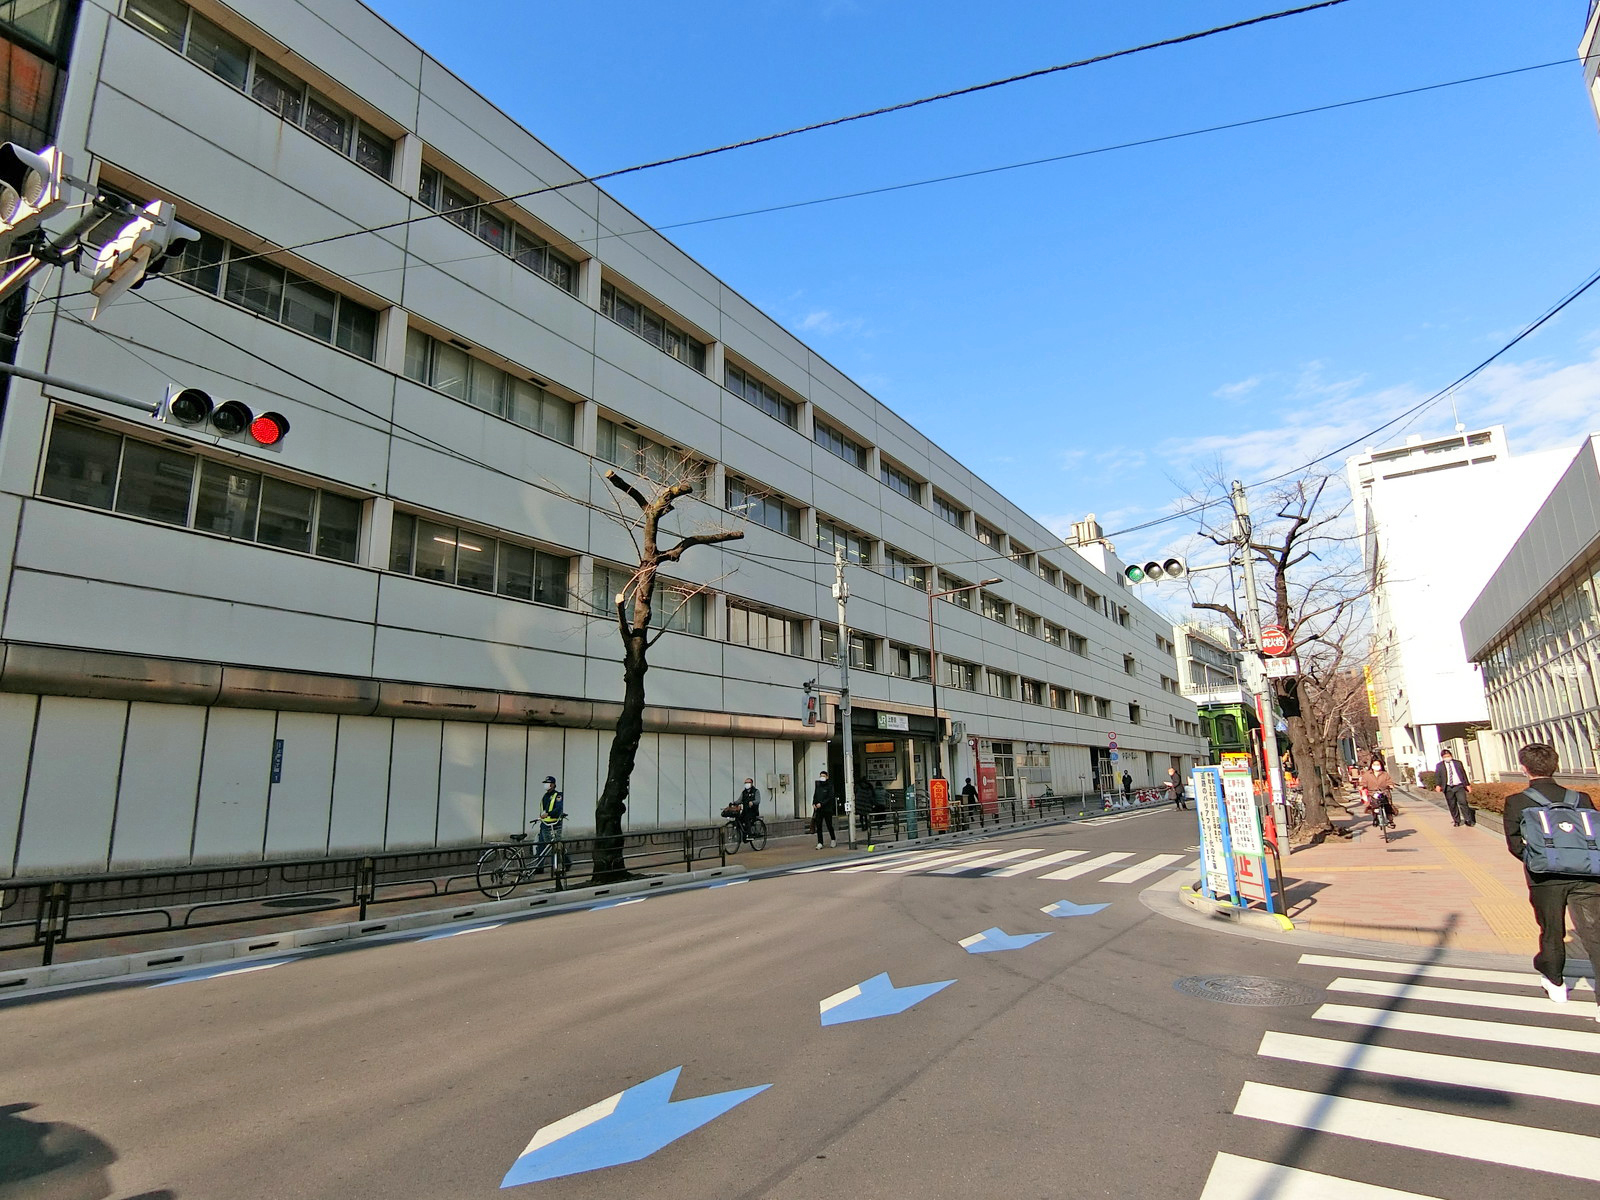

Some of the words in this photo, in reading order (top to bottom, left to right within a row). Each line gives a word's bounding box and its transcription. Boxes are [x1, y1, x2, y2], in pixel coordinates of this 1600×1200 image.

[1262, 636, 1285, 648] 消火栓
[879, 715, 886, 724] JR
